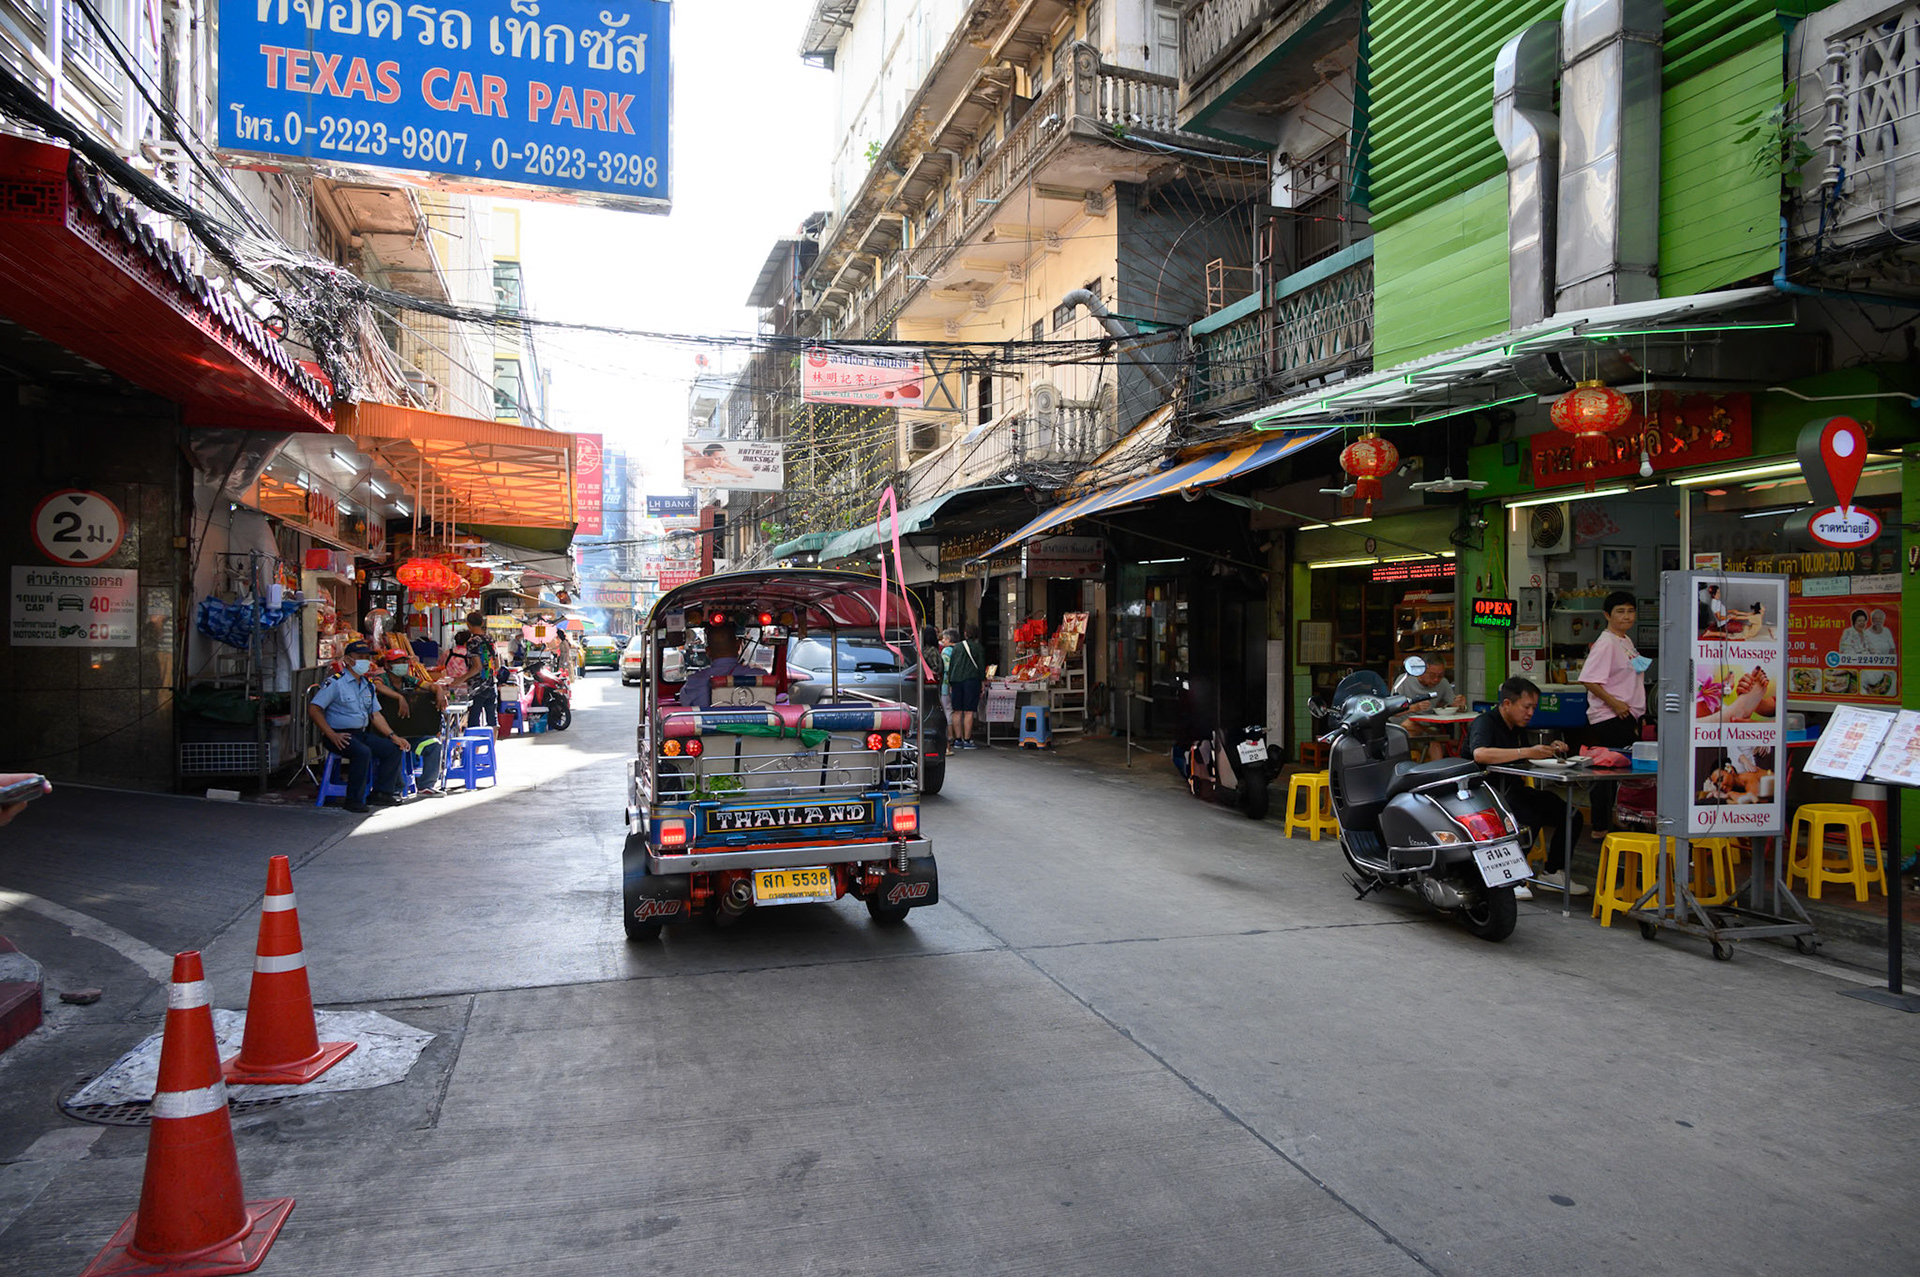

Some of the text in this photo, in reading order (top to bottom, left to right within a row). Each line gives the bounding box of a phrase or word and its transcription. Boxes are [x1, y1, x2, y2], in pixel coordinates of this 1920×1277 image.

[259, 44, 636, 135] TEXAS CAR PARK
[649, 500, 690, 508] LH BANK
[53, 511, 82, 543] 2
[1801, 551, 1855, 573] 10.00-20.00
[25, 603, 45, 612] CAR
[90, 597, 110, 613] 40
[1475, 600, 1513, 616] OPEN
[13, 630, 57, 639] MOTORCYCLE
[89, 624, 109, 640] 20
[1698, 644, 1777, 664] Thai Massage
[1841, 655, 1896, 664] 02-2249272
[1694, 727, 1776, 745] Foot Massage
[716, 804, 866, 830] THAILAND
[1697, 810, 1770, 827] Oil Massage
[792, 872, 828, 887] 5538
[1503, 869, 1512, 879] 8
[887, 882, 930, 905] 4WD
[633, 898, 682, 922] 4WD
